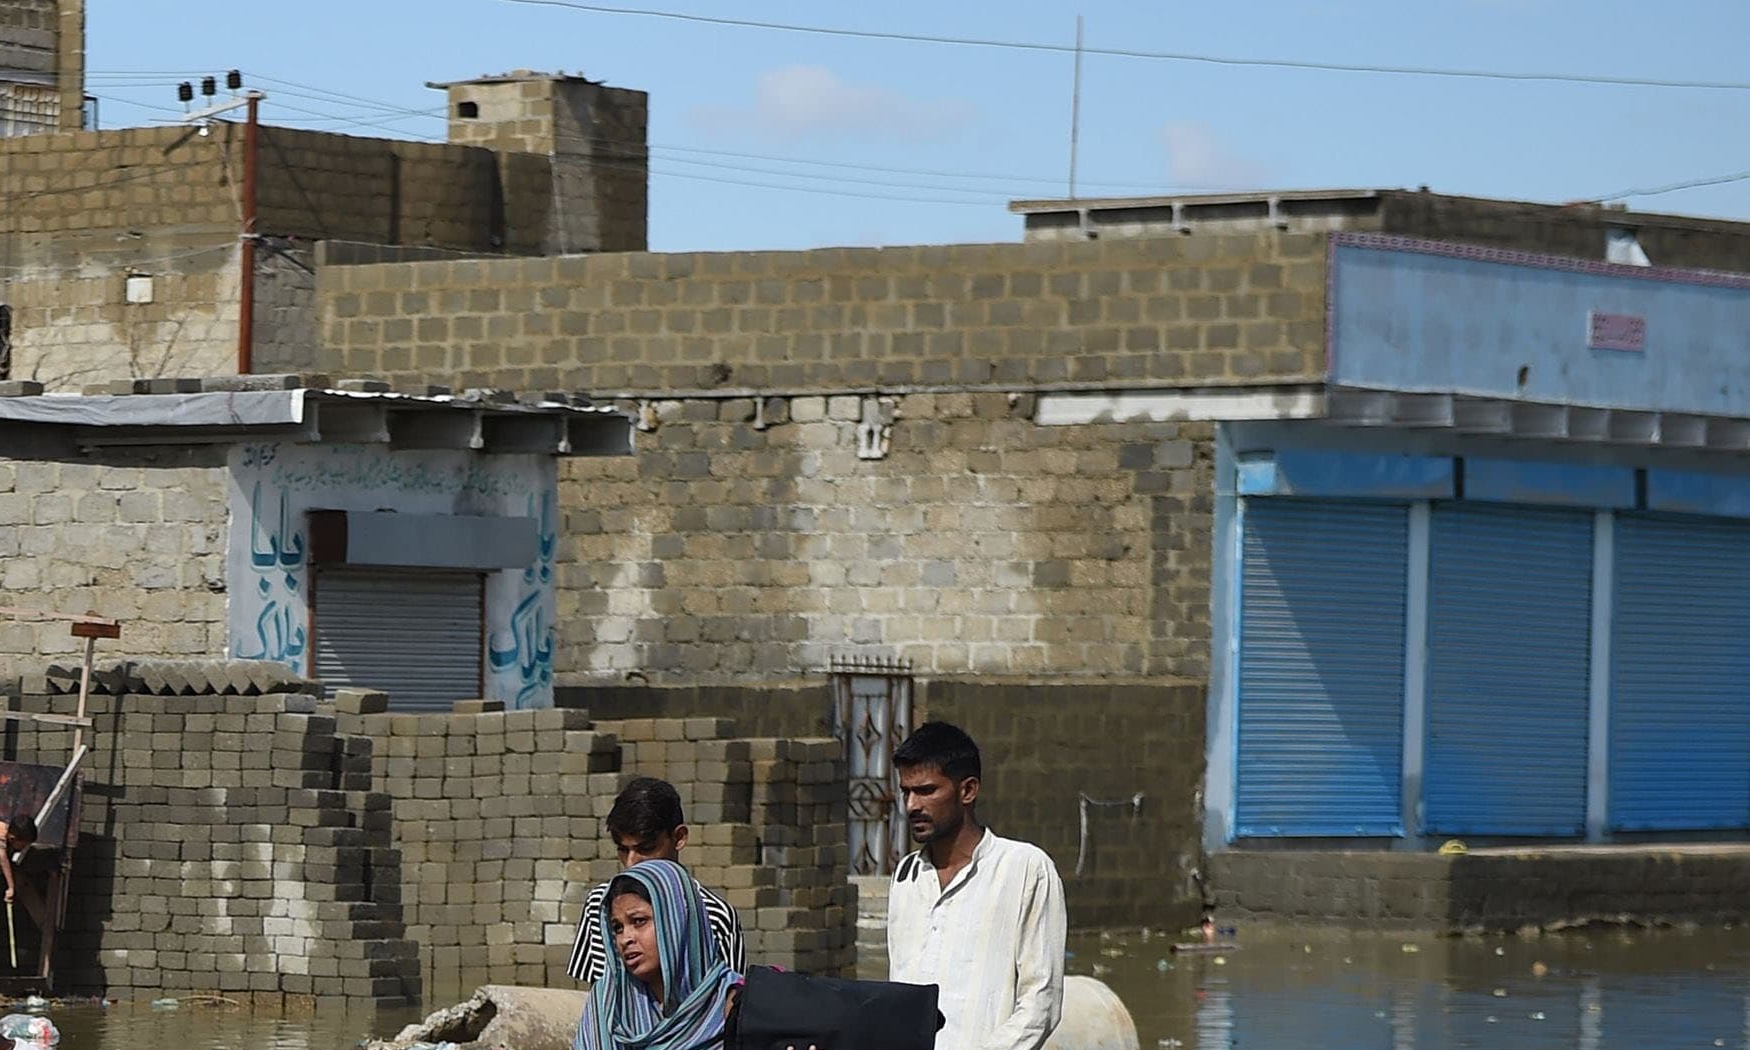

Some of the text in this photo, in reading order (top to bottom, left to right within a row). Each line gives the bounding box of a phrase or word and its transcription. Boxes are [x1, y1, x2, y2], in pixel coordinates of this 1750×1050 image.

[250, 480, 306, 598] بابا
[236, 600, 306, 674] بلاک
[489, 589, 556, 688] بلاک
